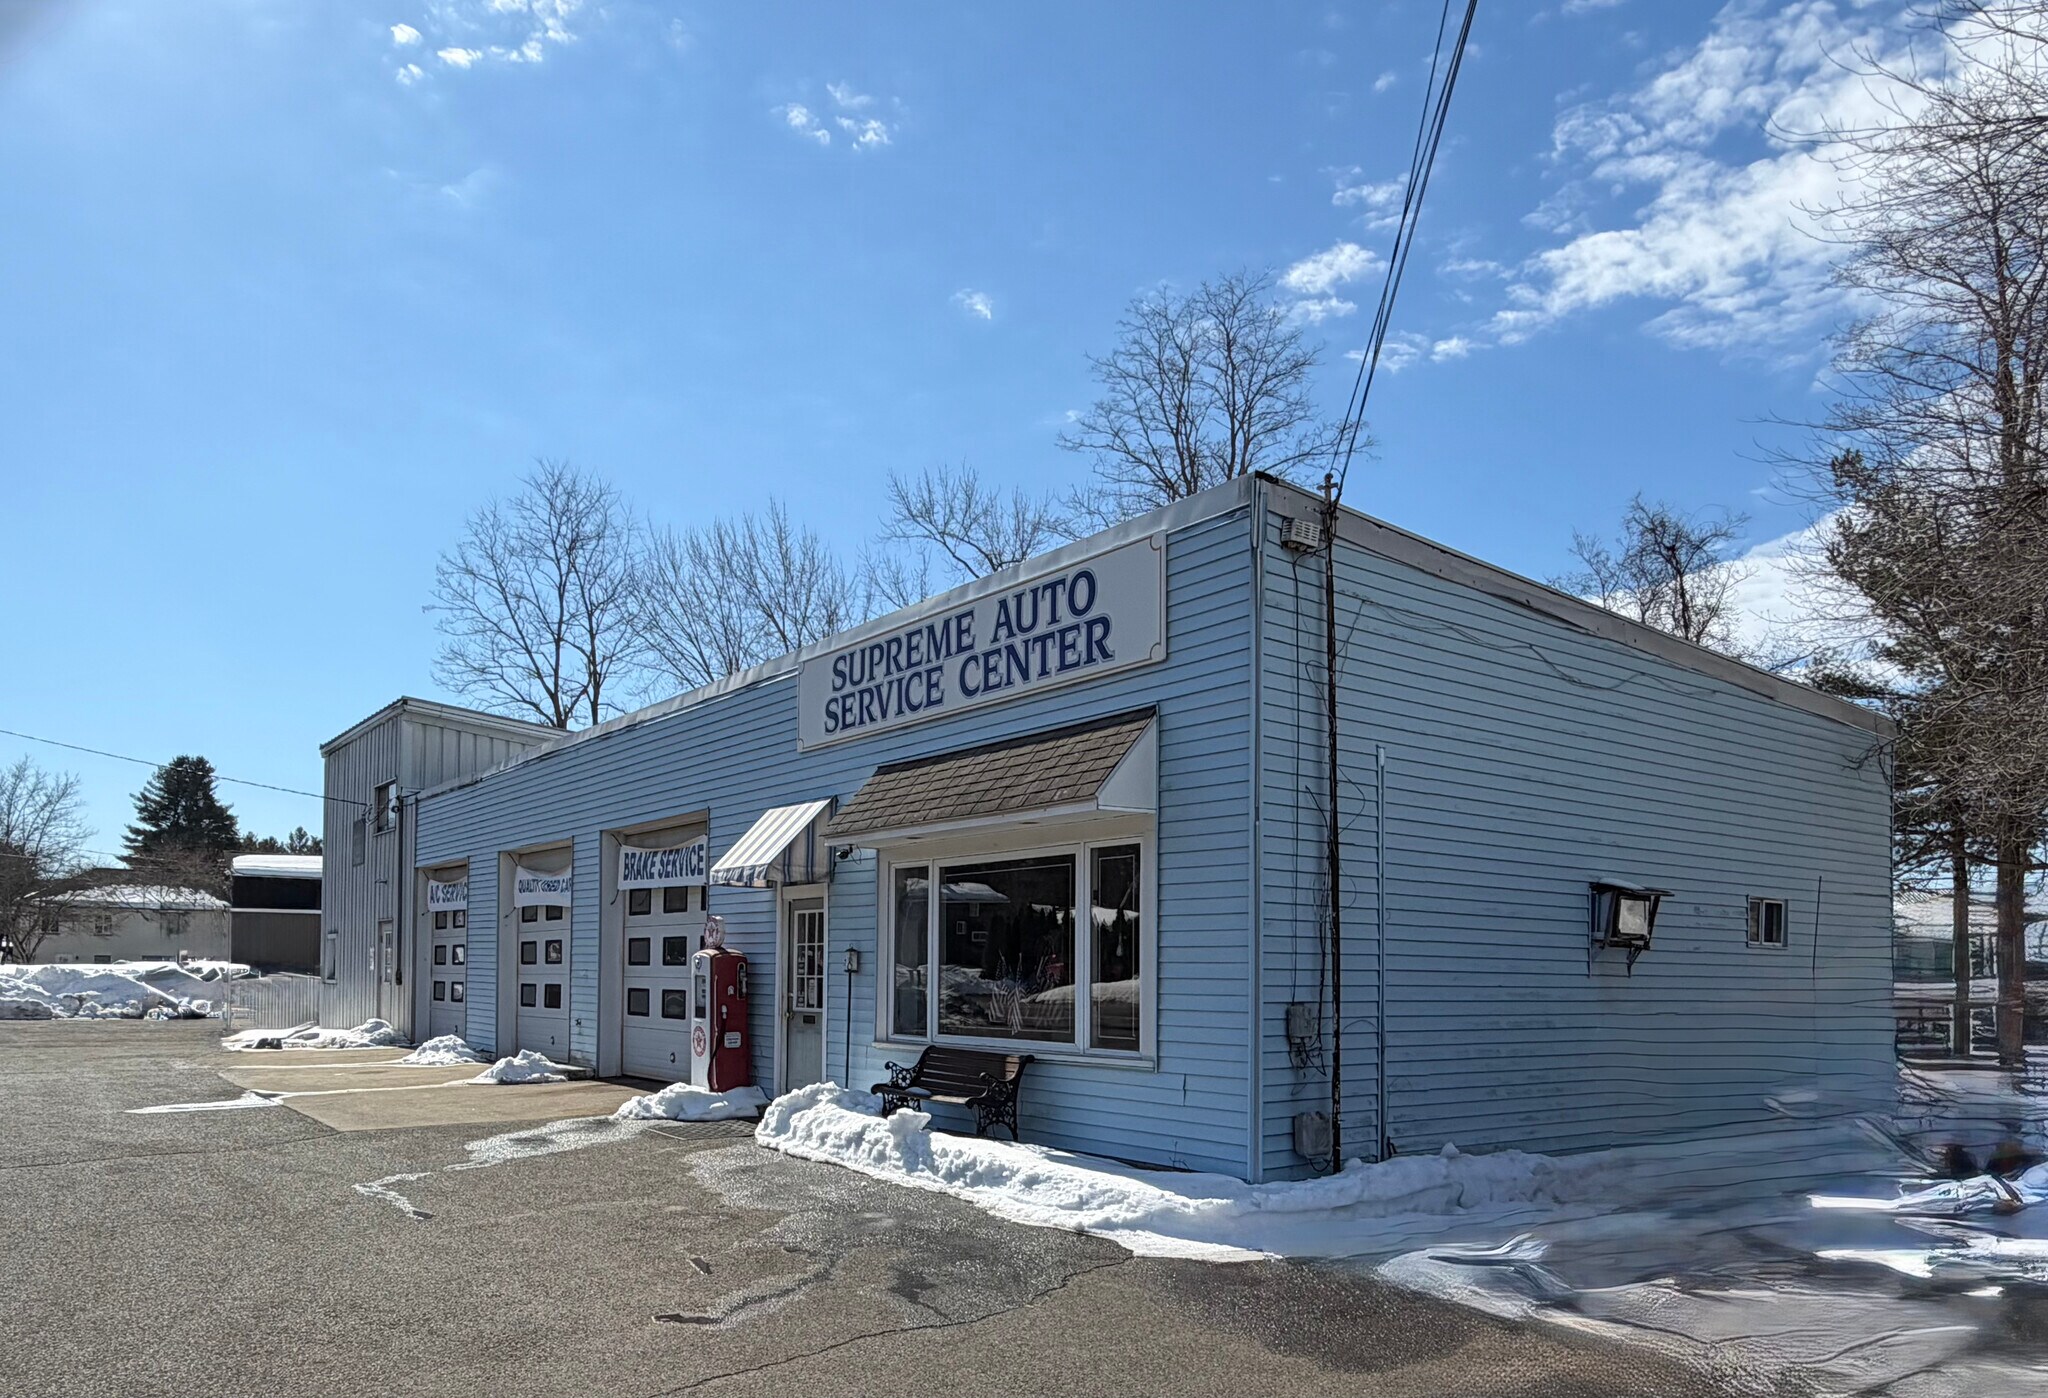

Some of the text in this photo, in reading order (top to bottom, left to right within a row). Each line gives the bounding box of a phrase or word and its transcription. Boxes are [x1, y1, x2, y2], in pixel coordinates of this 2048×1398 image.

[831, 568, 1098, 693] SUPREME AUTO
[824, 613, 1116, 736] SERVICE CENTER
[518, 879, 542, 894] QUALITY
[623, 843, 705, 882] BRAKE SERVICE
